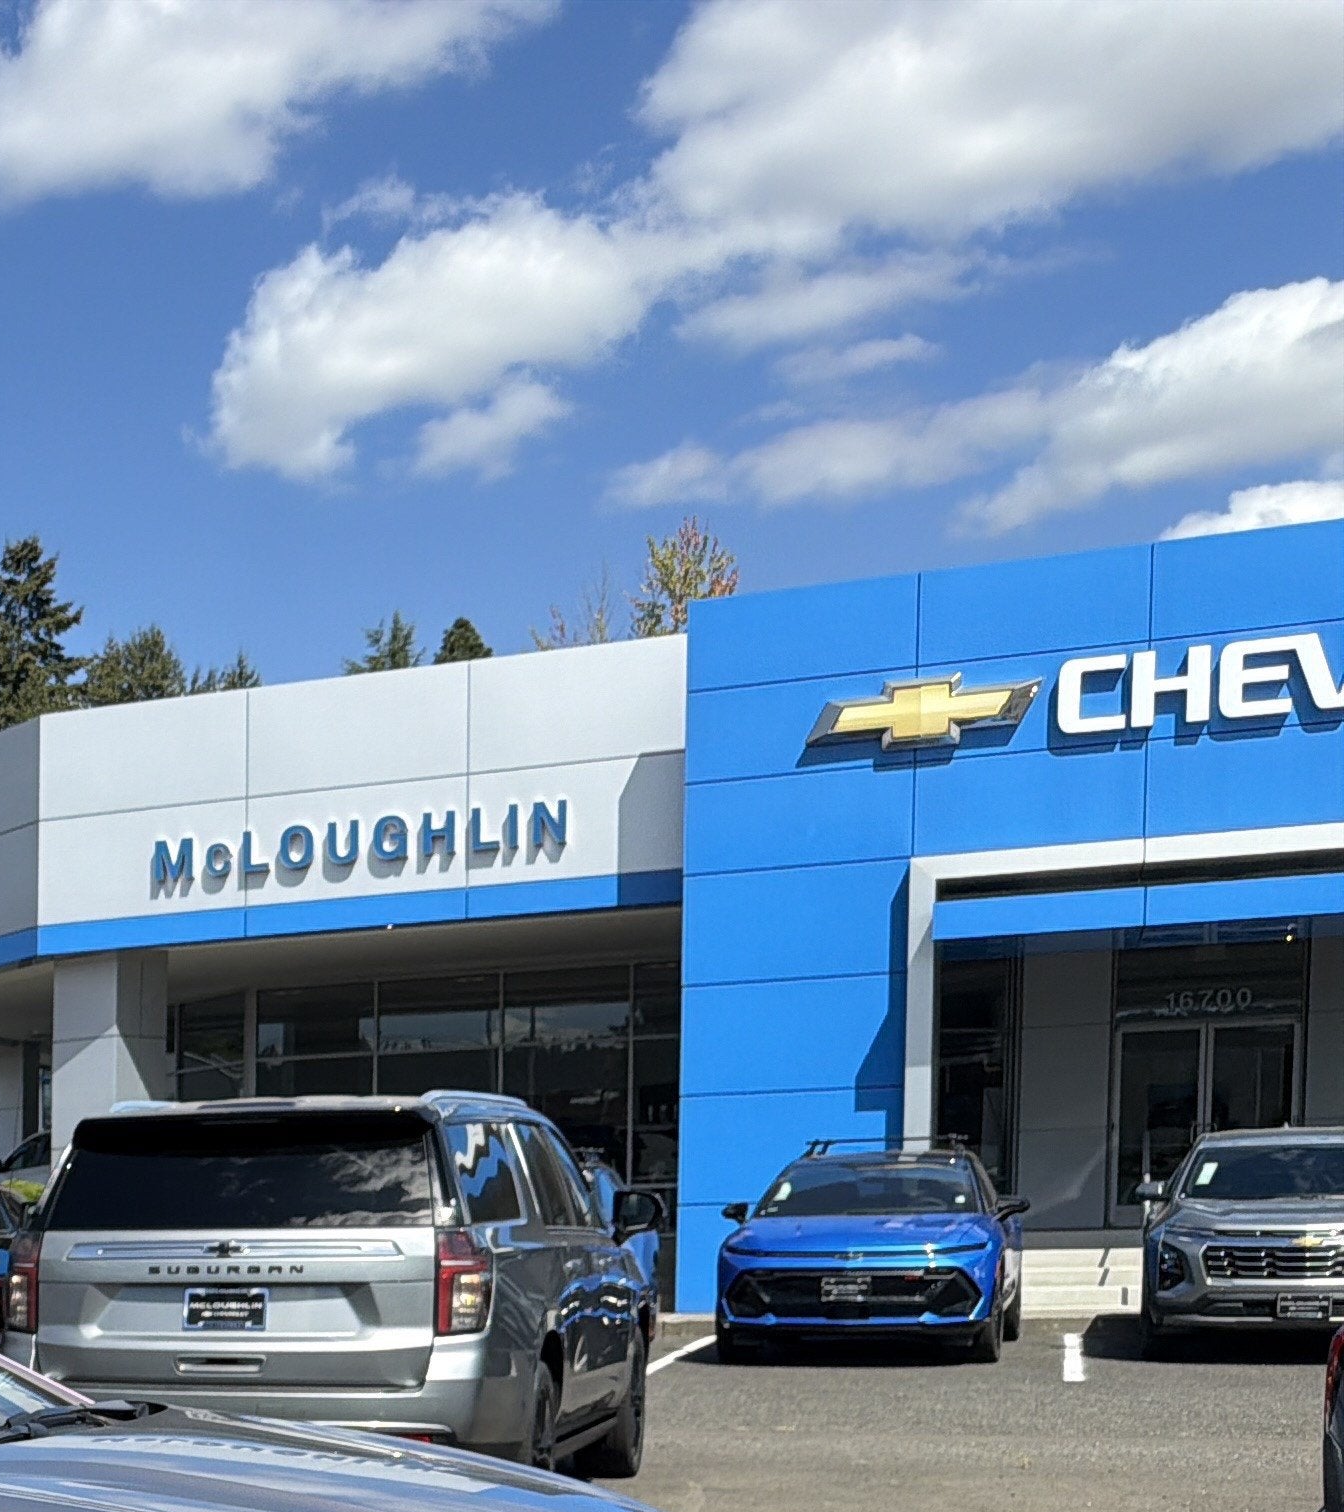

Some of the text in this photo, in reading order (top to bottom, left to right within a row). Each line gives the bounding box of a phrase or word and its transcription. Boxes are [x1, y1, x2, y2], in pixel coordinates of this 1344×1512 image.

[153, 799, 569, 884] McLOUGHLIN
[1165, 987, 1253, 1013] 16700
[148, 1264, 305, 1276] SUBURBAN
